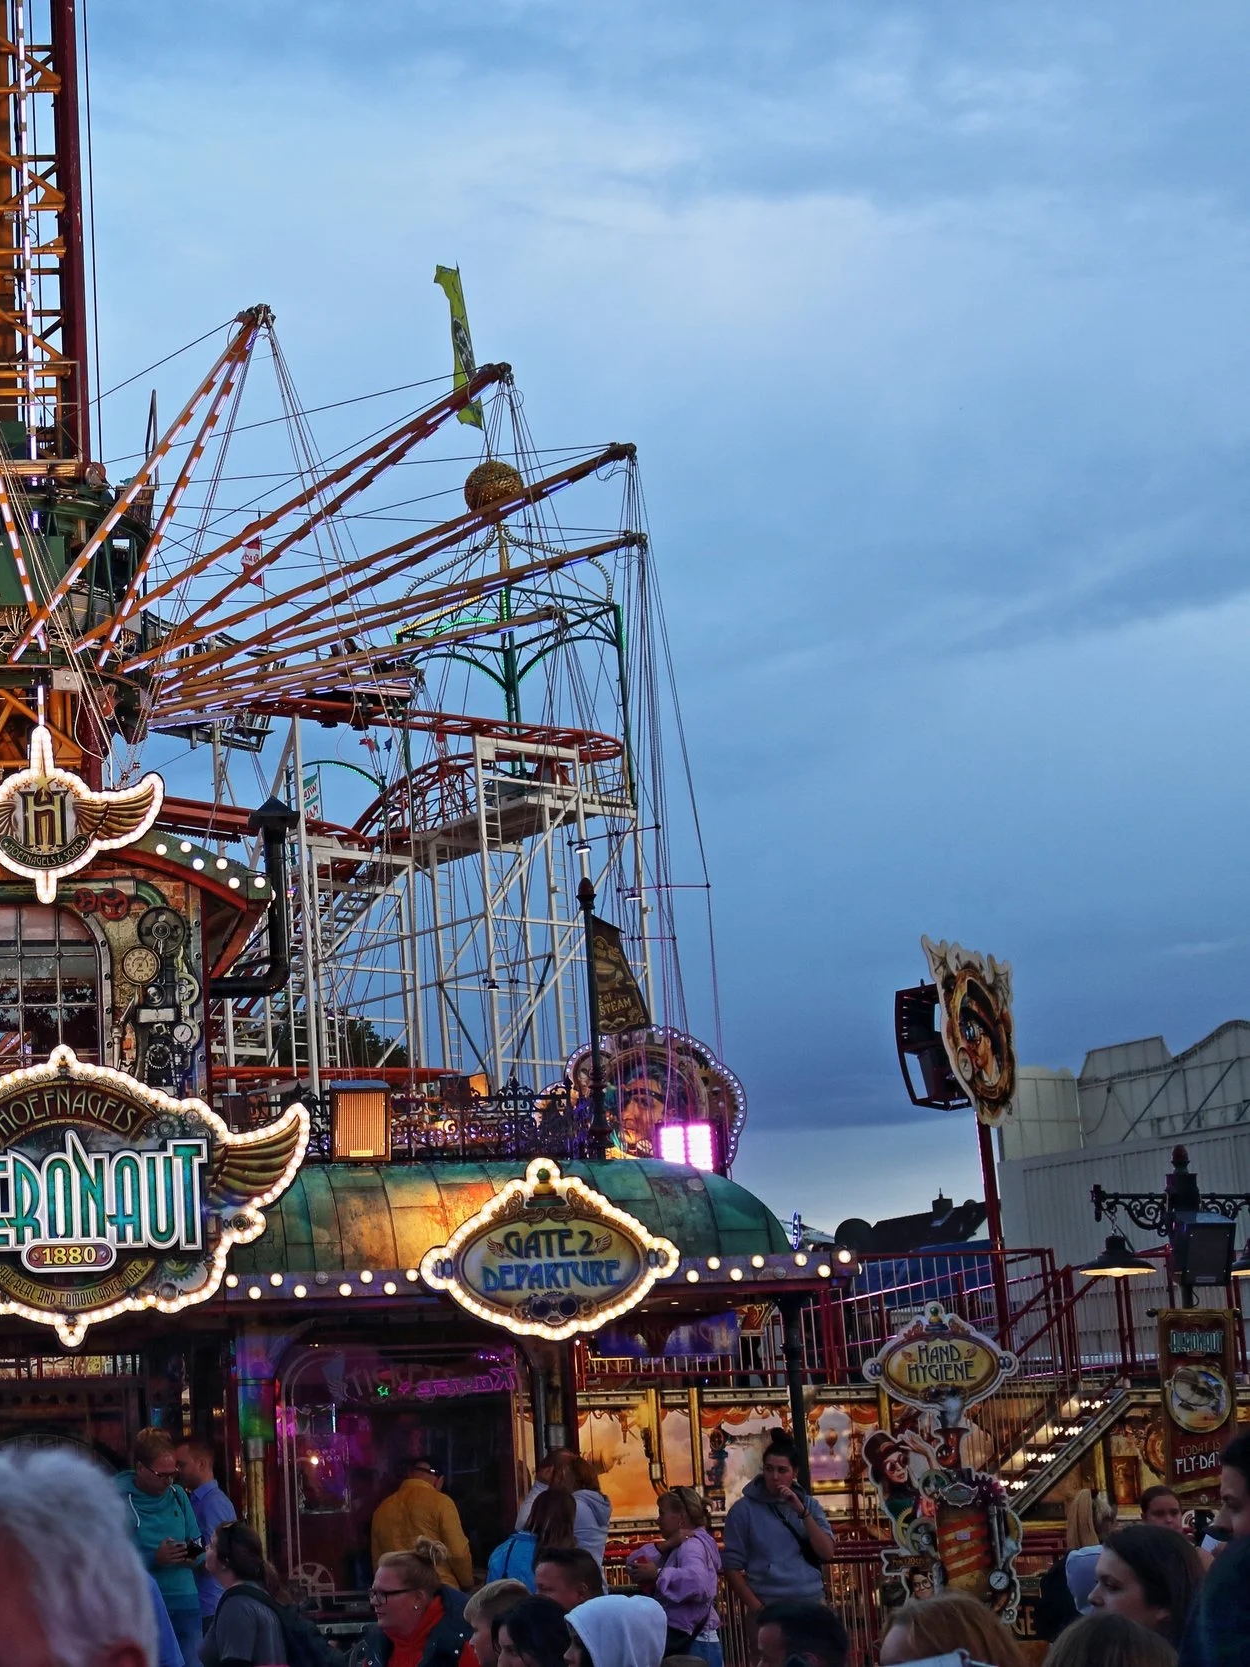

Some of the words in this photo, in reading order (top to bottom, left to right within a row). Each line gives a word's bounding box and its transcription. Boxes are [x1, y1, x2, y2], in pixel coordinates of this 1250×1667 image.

[7, 844, 56, 865] HOEFNAGELS
[64, 842, 84, 860] SONS
[599, 997, 632, 1016] STEAM
[42, 1246, 96, 1265] 1880
[504, 1229, 575, 1259] GATE
[578, 1229, 595, 1256] 2
[0, 1266, 14, 1286] THE
[13, 1277, 35, 1299] REAL
[37, 1290, 55, 1305] AND
[58, 1291, 96, 1307] FAMOUS
[99, 1262, 144, 1299] ADVENTURE
[481, 1260, 622, 1291] DEPARTURE
[917, 1343, 961, 1363] HAND
[907, 1360, 976, 1383] HYGIENE
